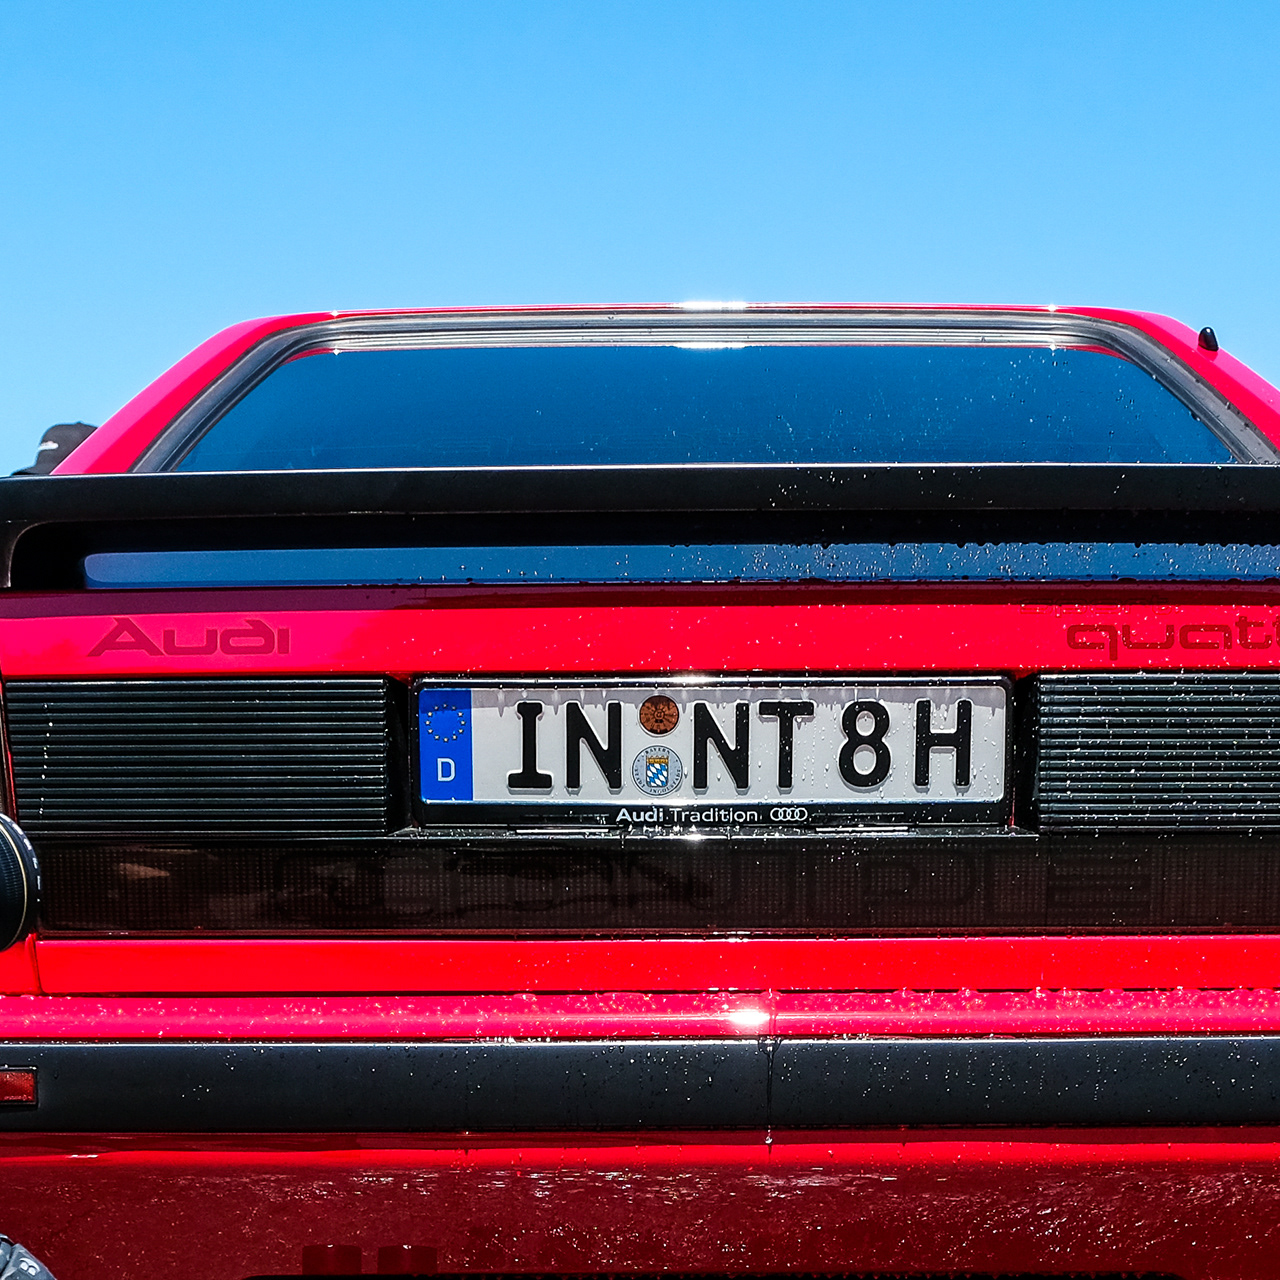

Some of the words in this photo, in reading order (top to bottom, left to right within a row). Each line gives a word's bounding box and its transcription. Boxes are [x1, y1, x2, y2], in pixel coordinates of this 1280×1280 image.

[86, 616, 291, 657] Audi
[508, 700, 623, 790] IN
[692, 700, 816, 790] NT
[436, 757, 457, 782] D
[616, 807, 664, 823] Audi
[669, 807, 758, 823] Tradition
